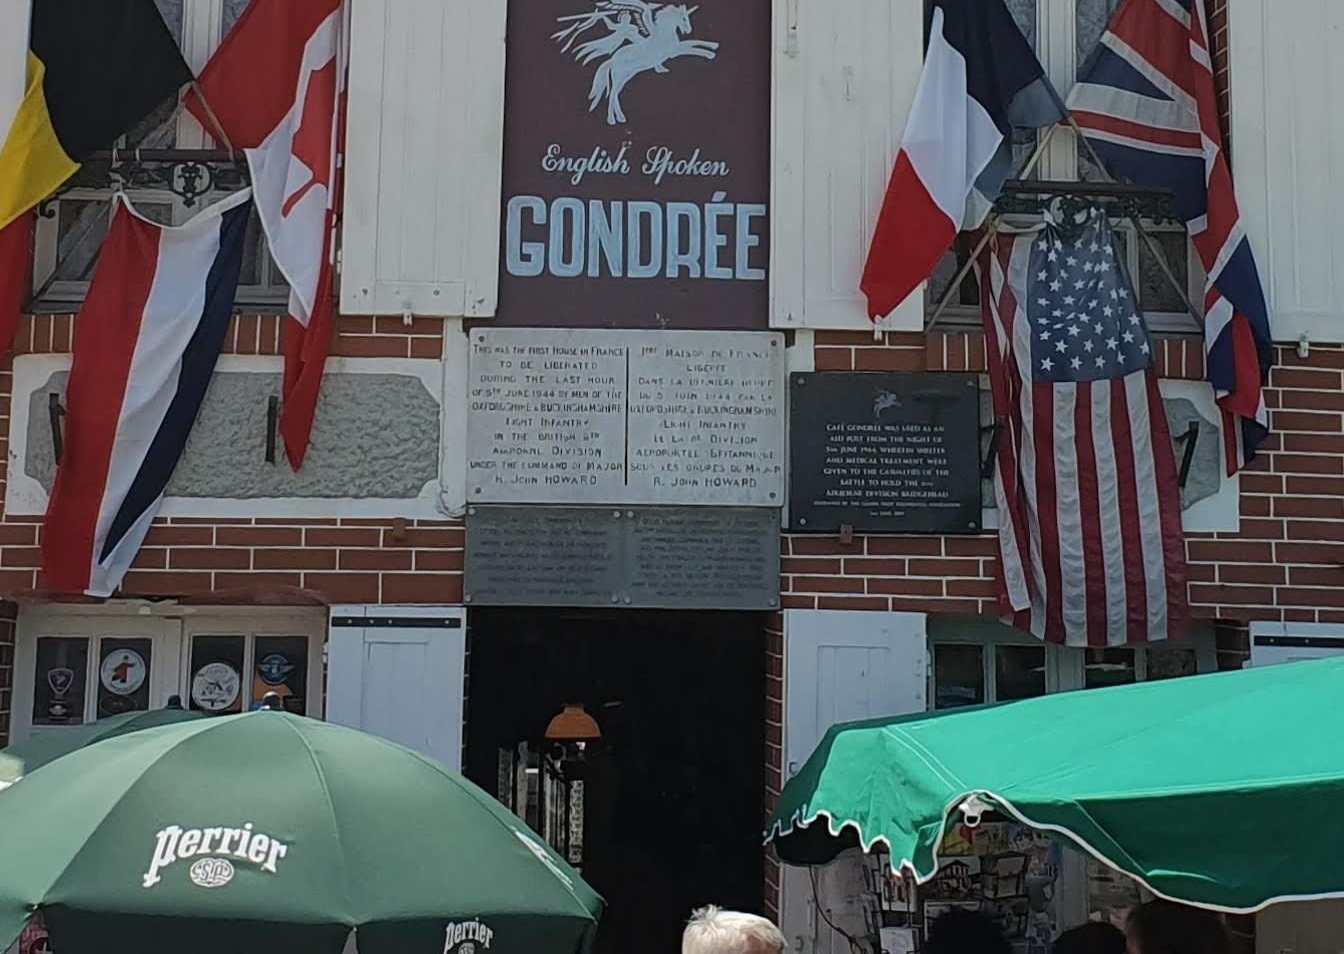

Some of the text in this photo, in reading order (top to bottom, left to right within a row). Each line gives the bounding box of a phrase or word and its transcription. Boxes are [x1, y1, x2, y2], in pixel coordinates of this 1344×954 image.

[542, 143, 729, 185] English Spoken
[506, 191, 766, 280] GONDRÉE
[546, 475, 596, 485] HOWARD
[705, 478, 756, 487] HOWARD
